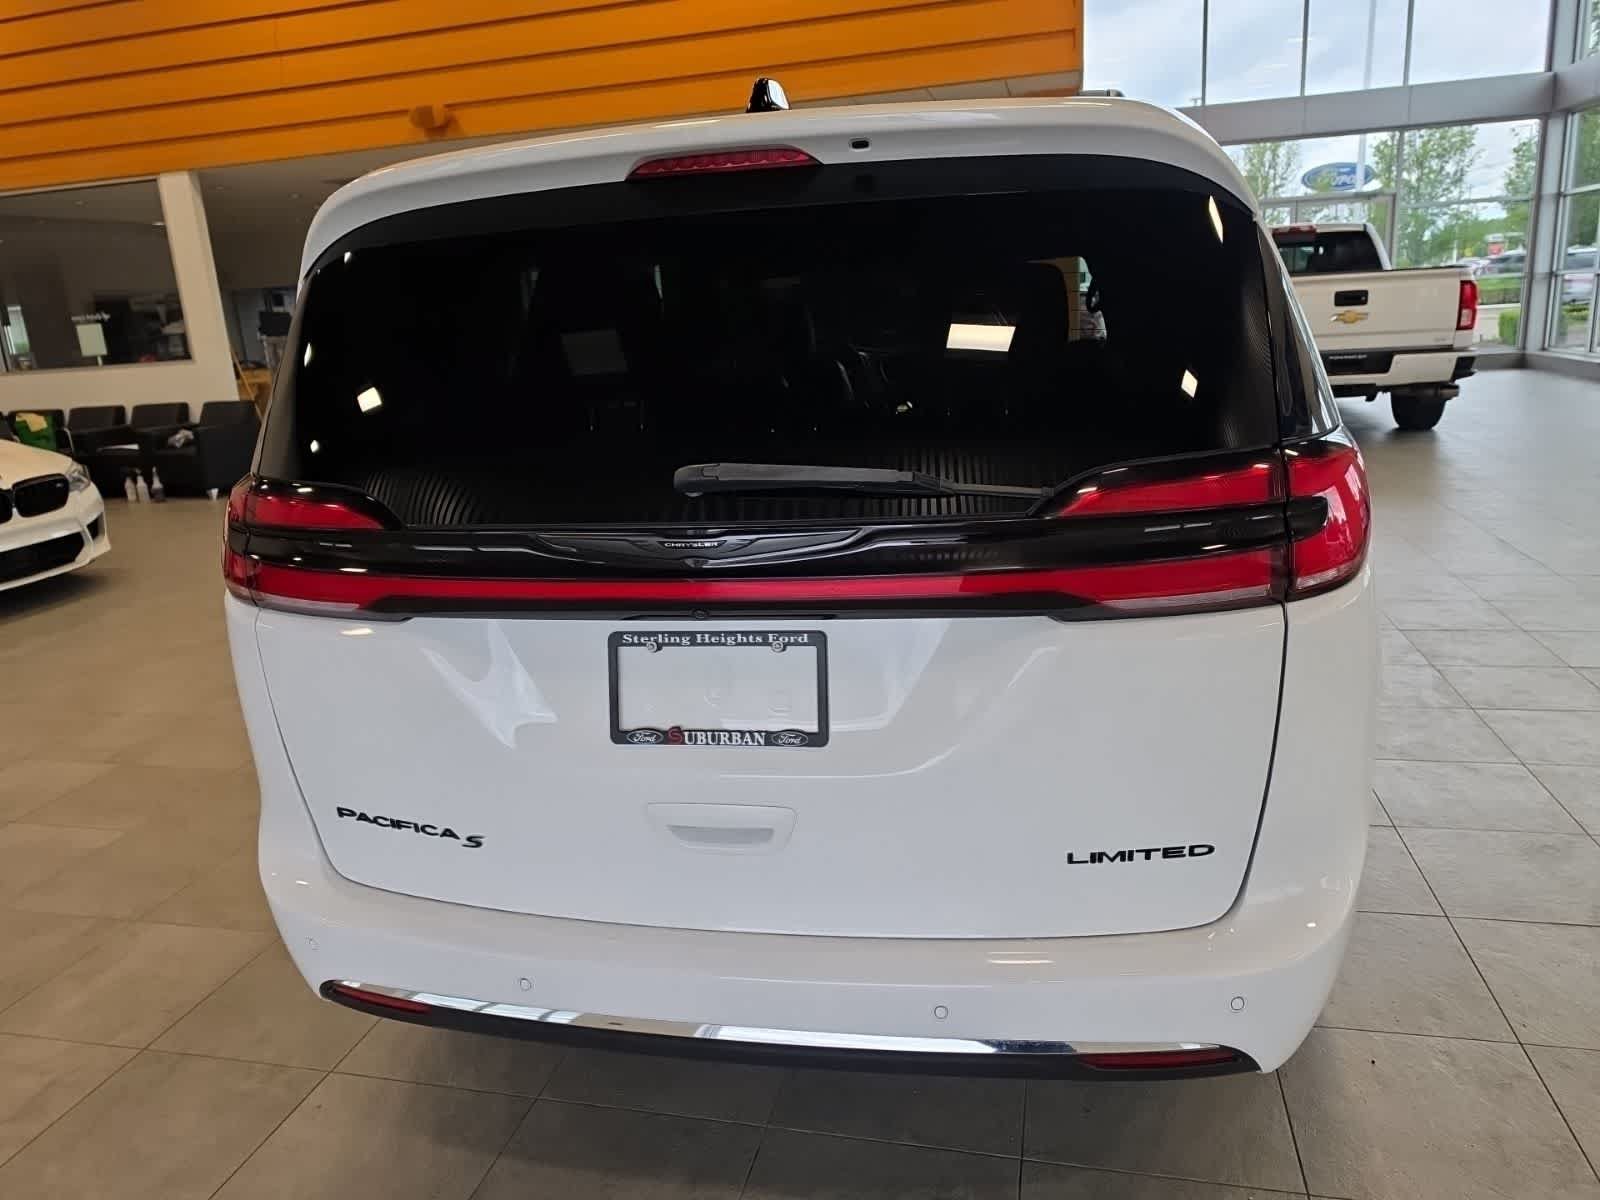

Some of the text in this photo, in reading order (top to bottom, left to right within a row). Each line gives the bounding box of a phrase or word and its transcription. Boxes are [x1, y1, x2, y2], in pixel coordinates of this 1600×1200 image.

[622, 633, 809, 645] Sterling Heights Ford
[632, 730, 658, 743] Ford
[667, 726, 767, 745] SUBURBAN
[777, 732, 802, 745] Ford
[336, 806, 485, 848] PACIFICA S
[1066, 844, 1216, 865] LIMITED
